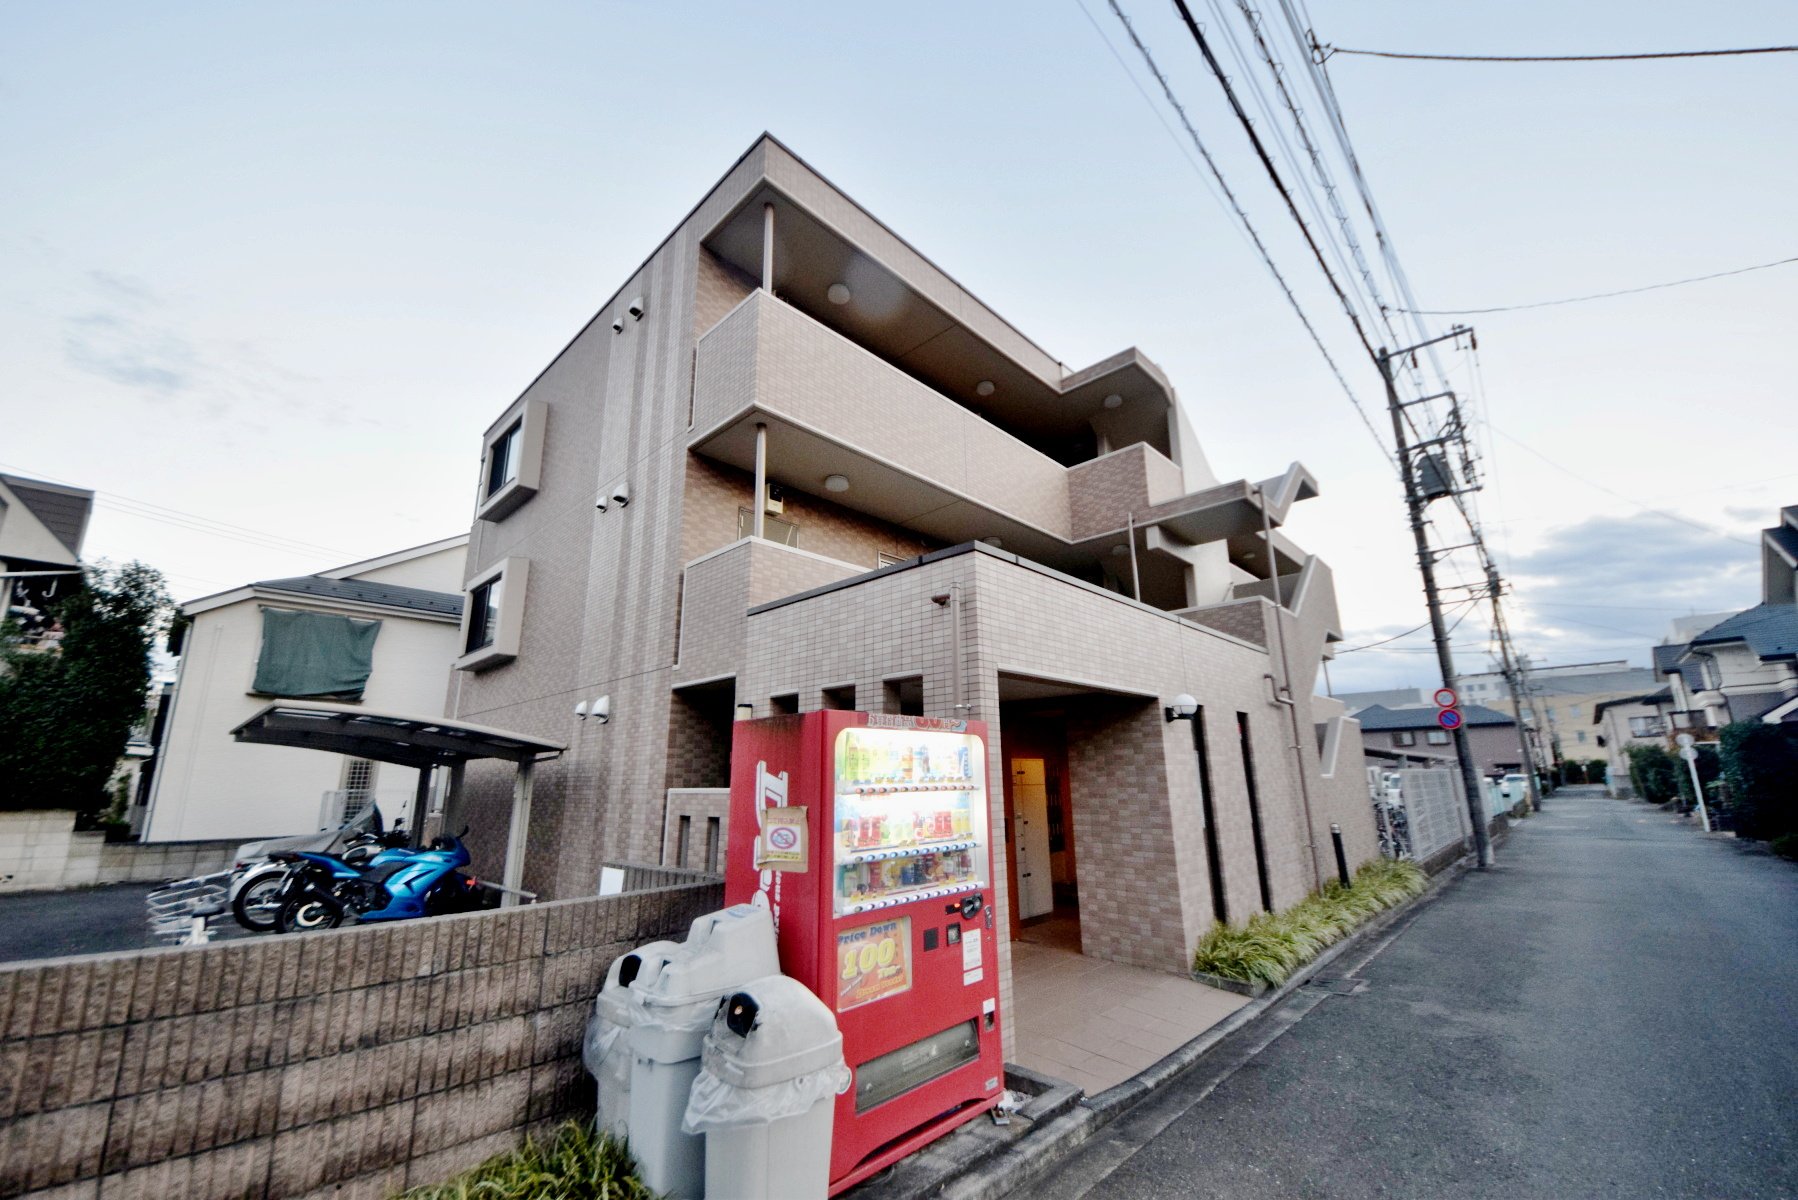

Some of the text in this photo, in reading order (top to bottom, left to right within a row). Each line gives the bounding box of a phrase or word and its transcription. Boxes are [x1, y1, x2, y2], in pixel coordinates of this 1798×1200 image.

[838, 922, 896, 943] Price Down
[842, 939, 895, 979] 100
